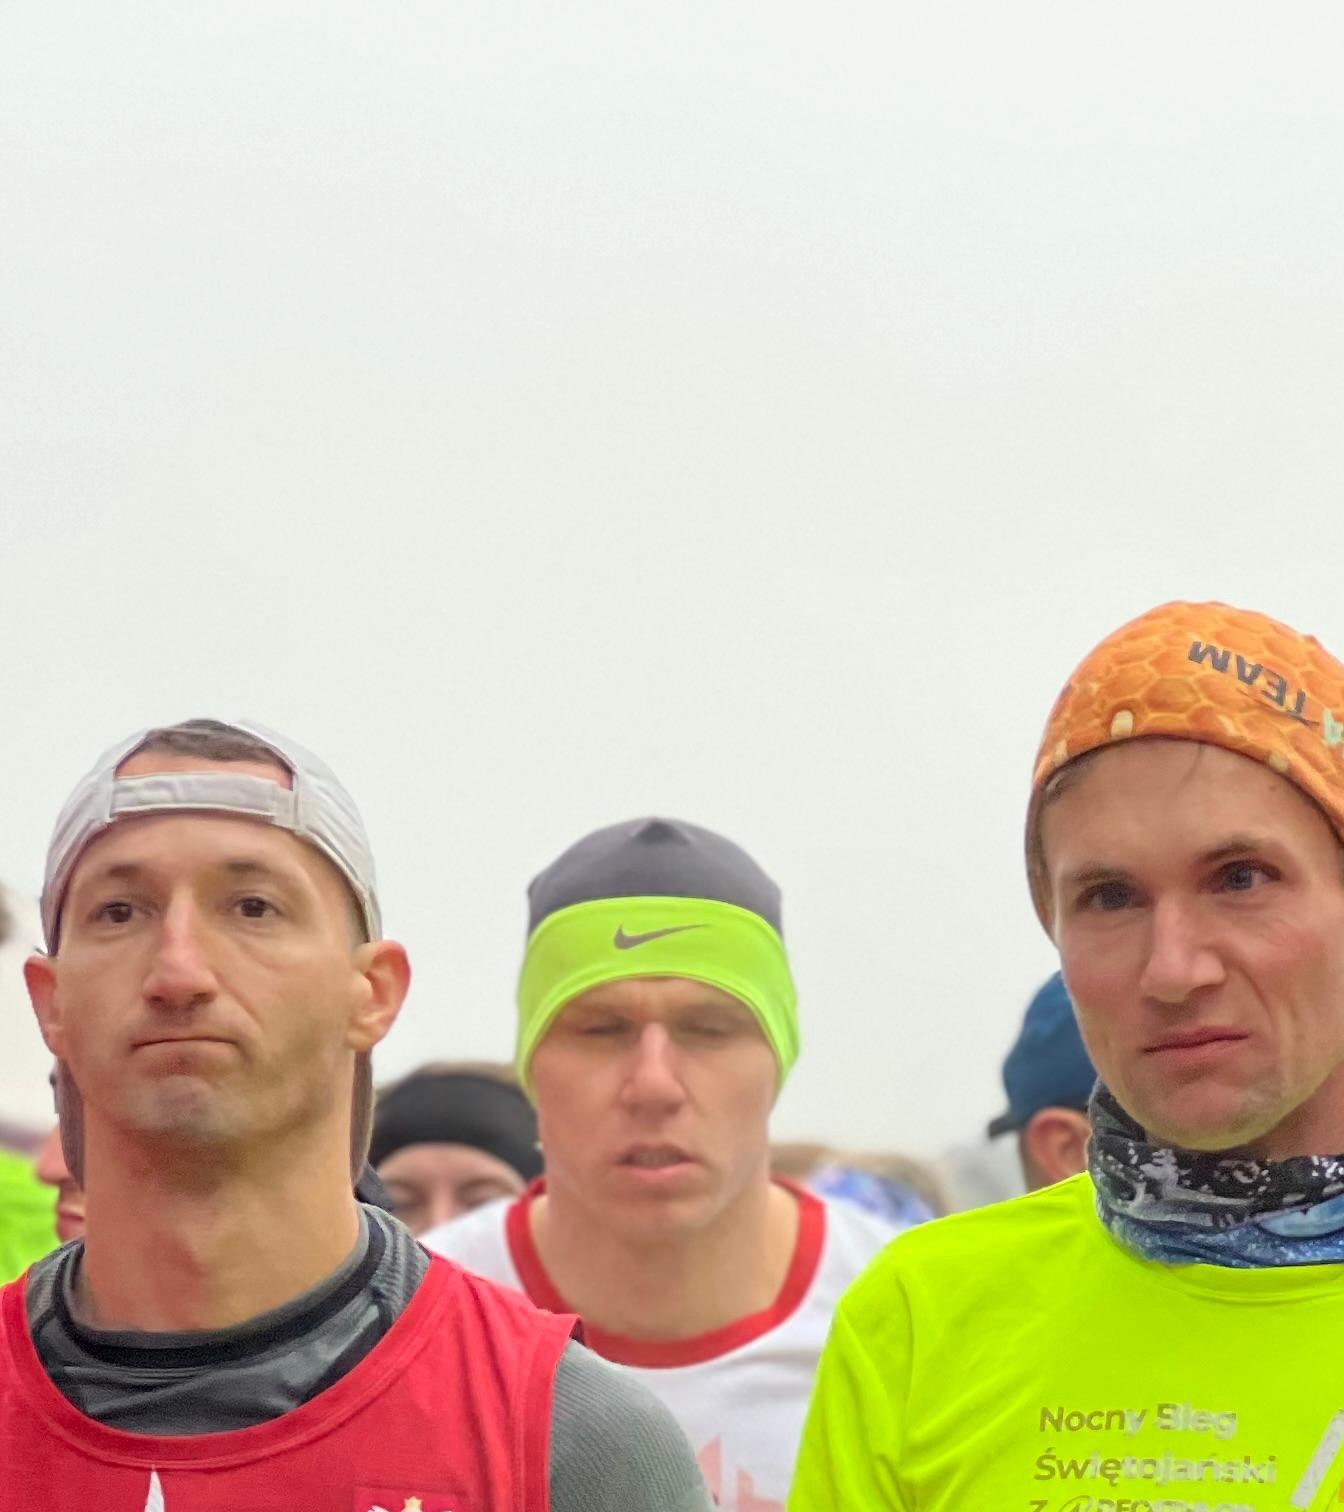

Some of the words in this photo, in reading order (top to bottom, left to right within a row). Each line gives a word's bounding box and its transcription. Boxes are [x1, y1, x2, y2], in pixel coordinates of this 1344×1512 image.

[1187, 640, 1320, 727] TEAM
[1038, 1405, 1149, 1437] Nocny
[1155, 1401, 1238, 1440] Bieg
[1033, 1446, 1277, 1488] Świętojański
